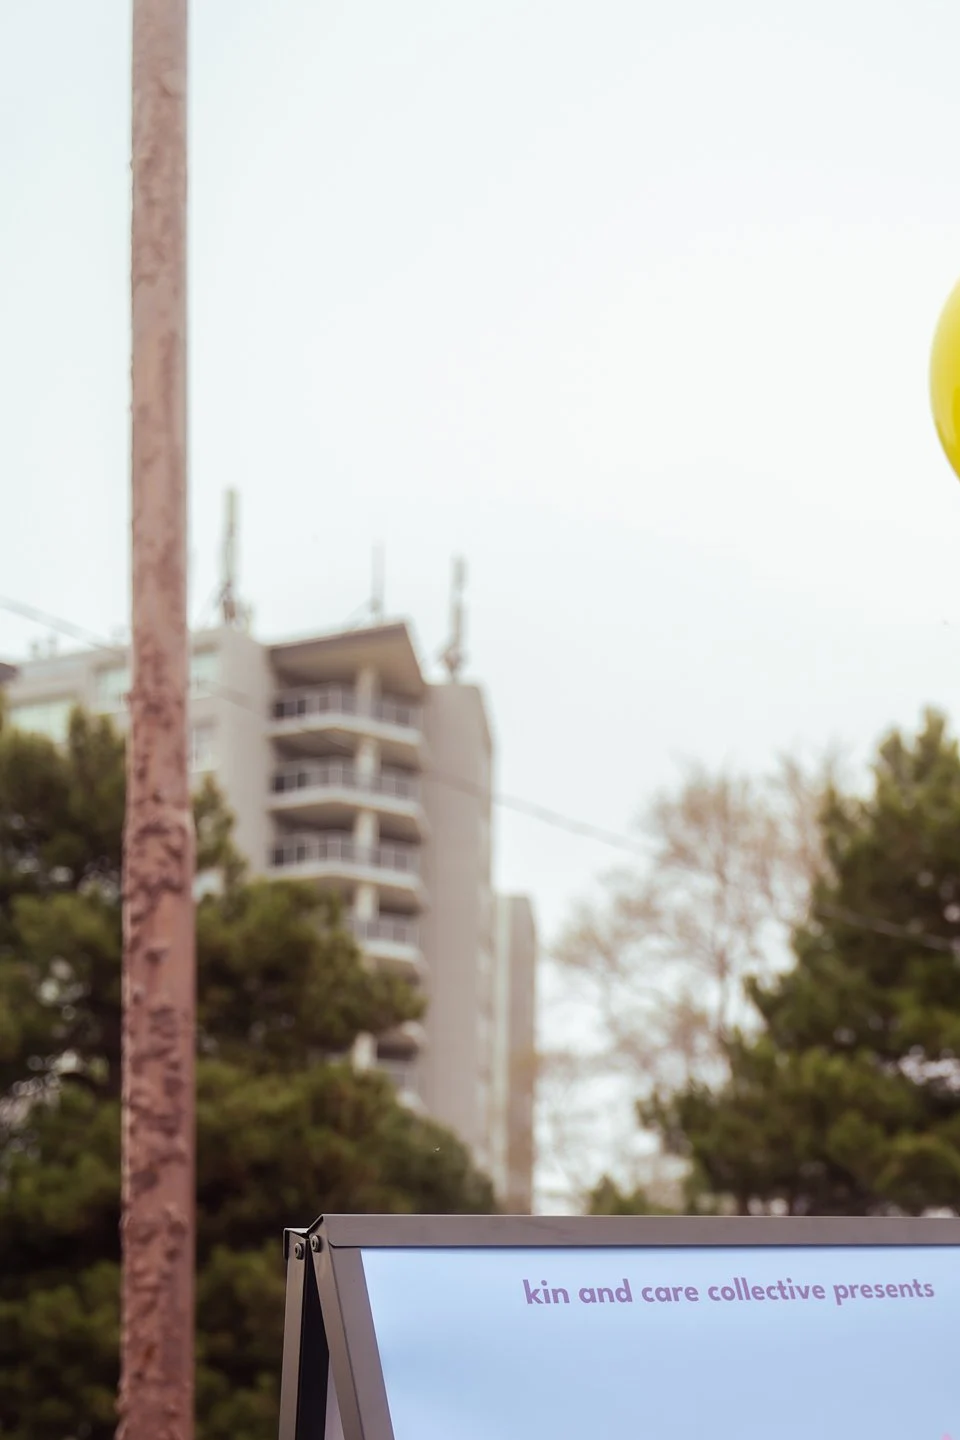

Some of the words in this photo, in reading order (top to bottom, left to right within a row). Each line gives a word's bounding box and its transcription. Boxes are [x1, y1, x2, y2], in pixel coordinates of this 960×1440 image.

[522, 1279, 570, 1304] kin
[578, 1278, 633, 1303] and
[641, 1281, 699, 1302] care
[707, 1277, 826, 1302] collective
[833, 1278, 935, 1305] presents
